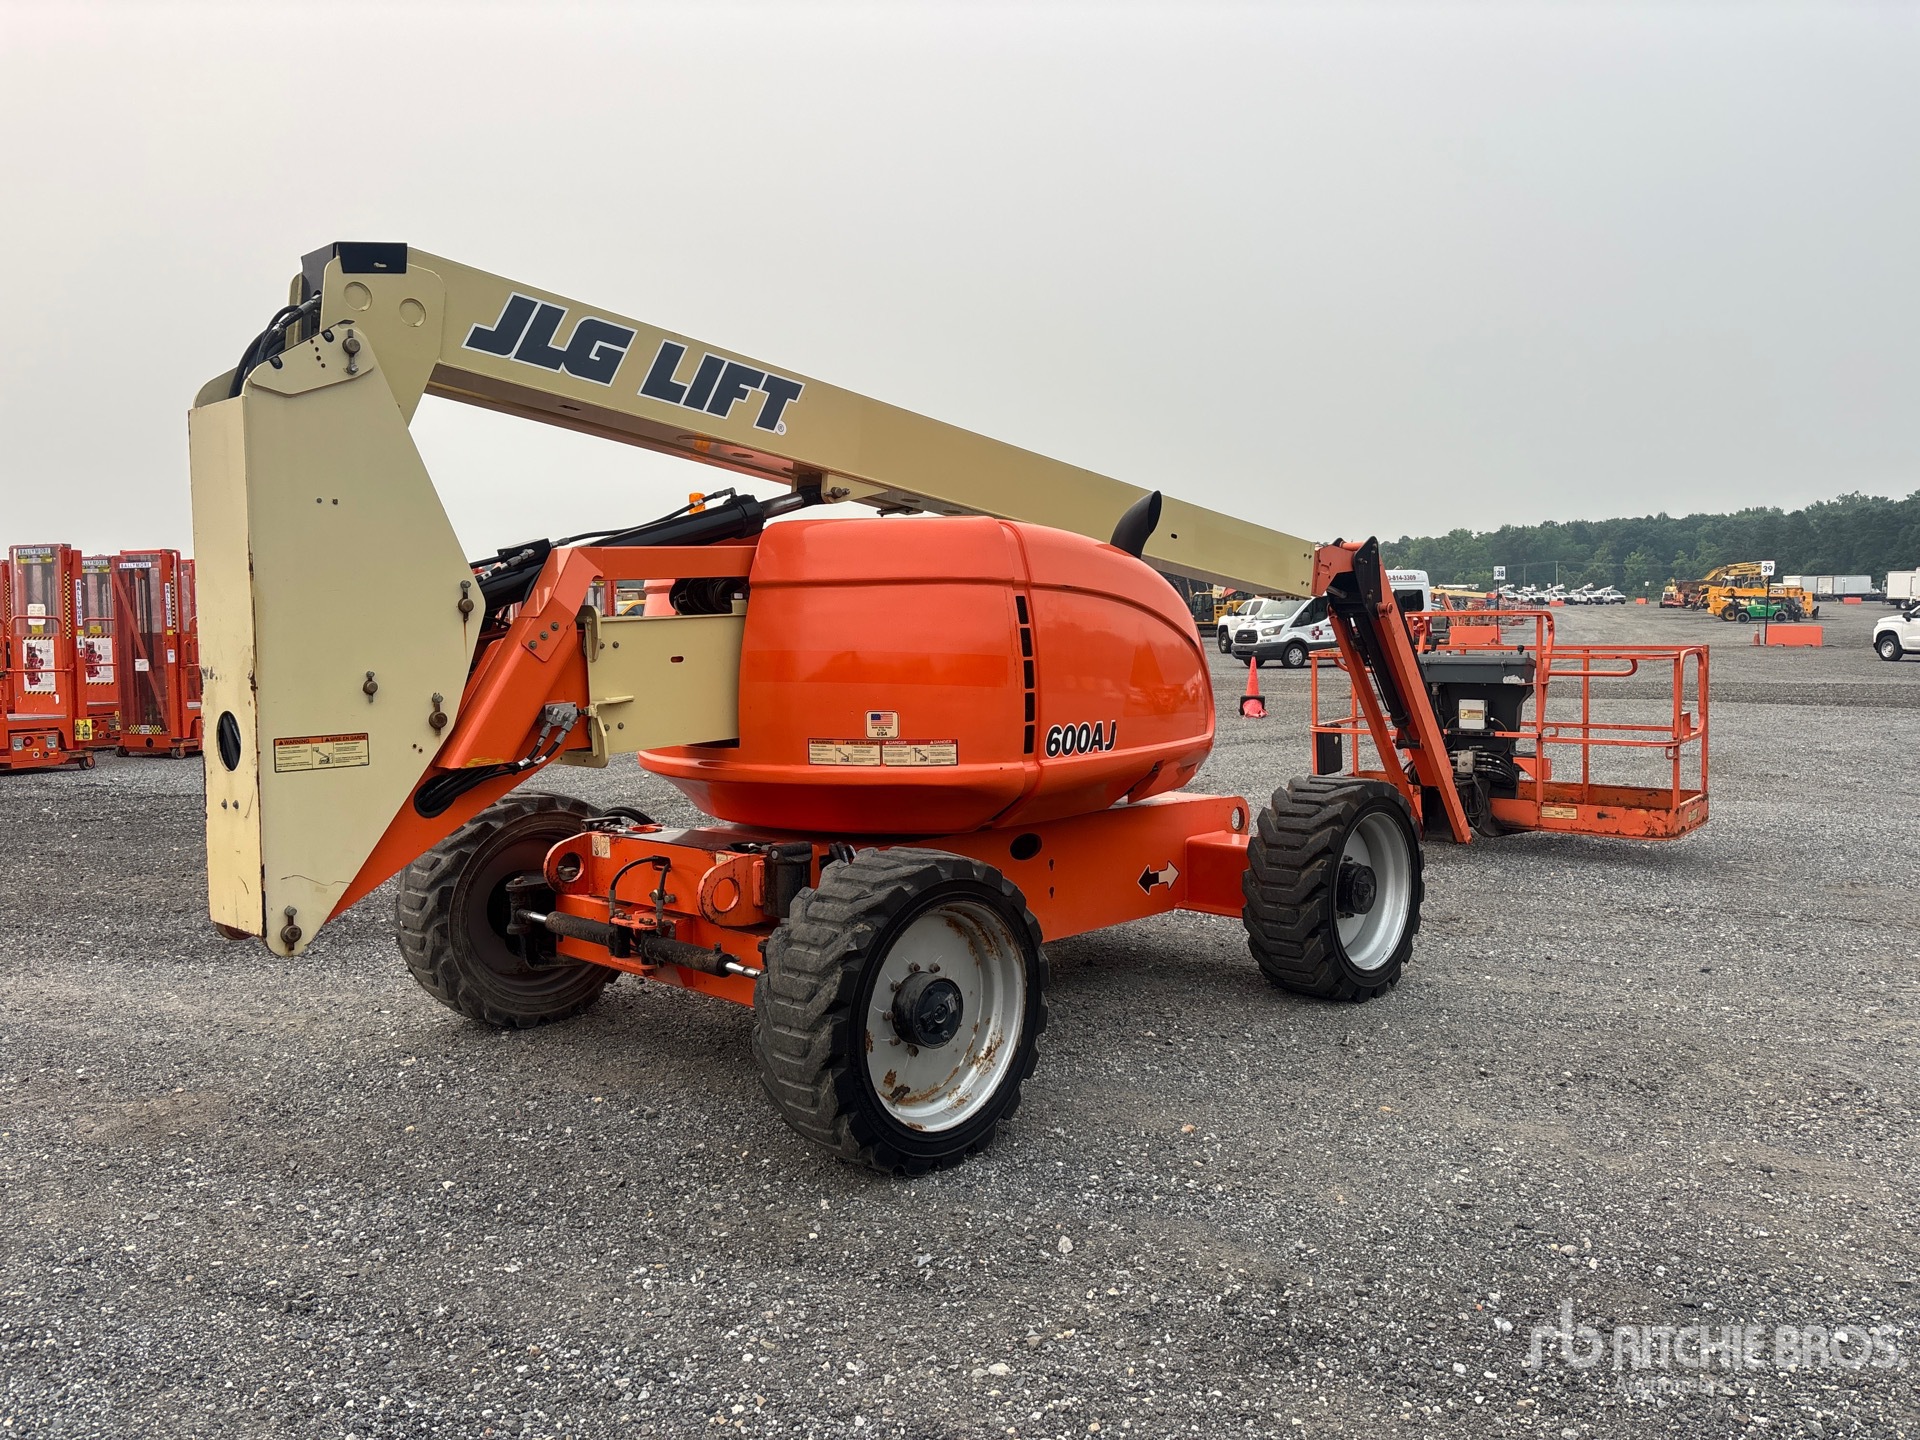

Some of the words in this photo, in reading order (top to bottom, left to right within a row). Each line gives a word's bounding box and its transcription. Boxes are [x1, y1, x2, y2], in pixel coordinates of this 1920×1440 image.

[461, 291, 638, 388] JLG
[637, 338, 806, 434] LIFT
[1046, 720, 1117, 758] 600AJ
